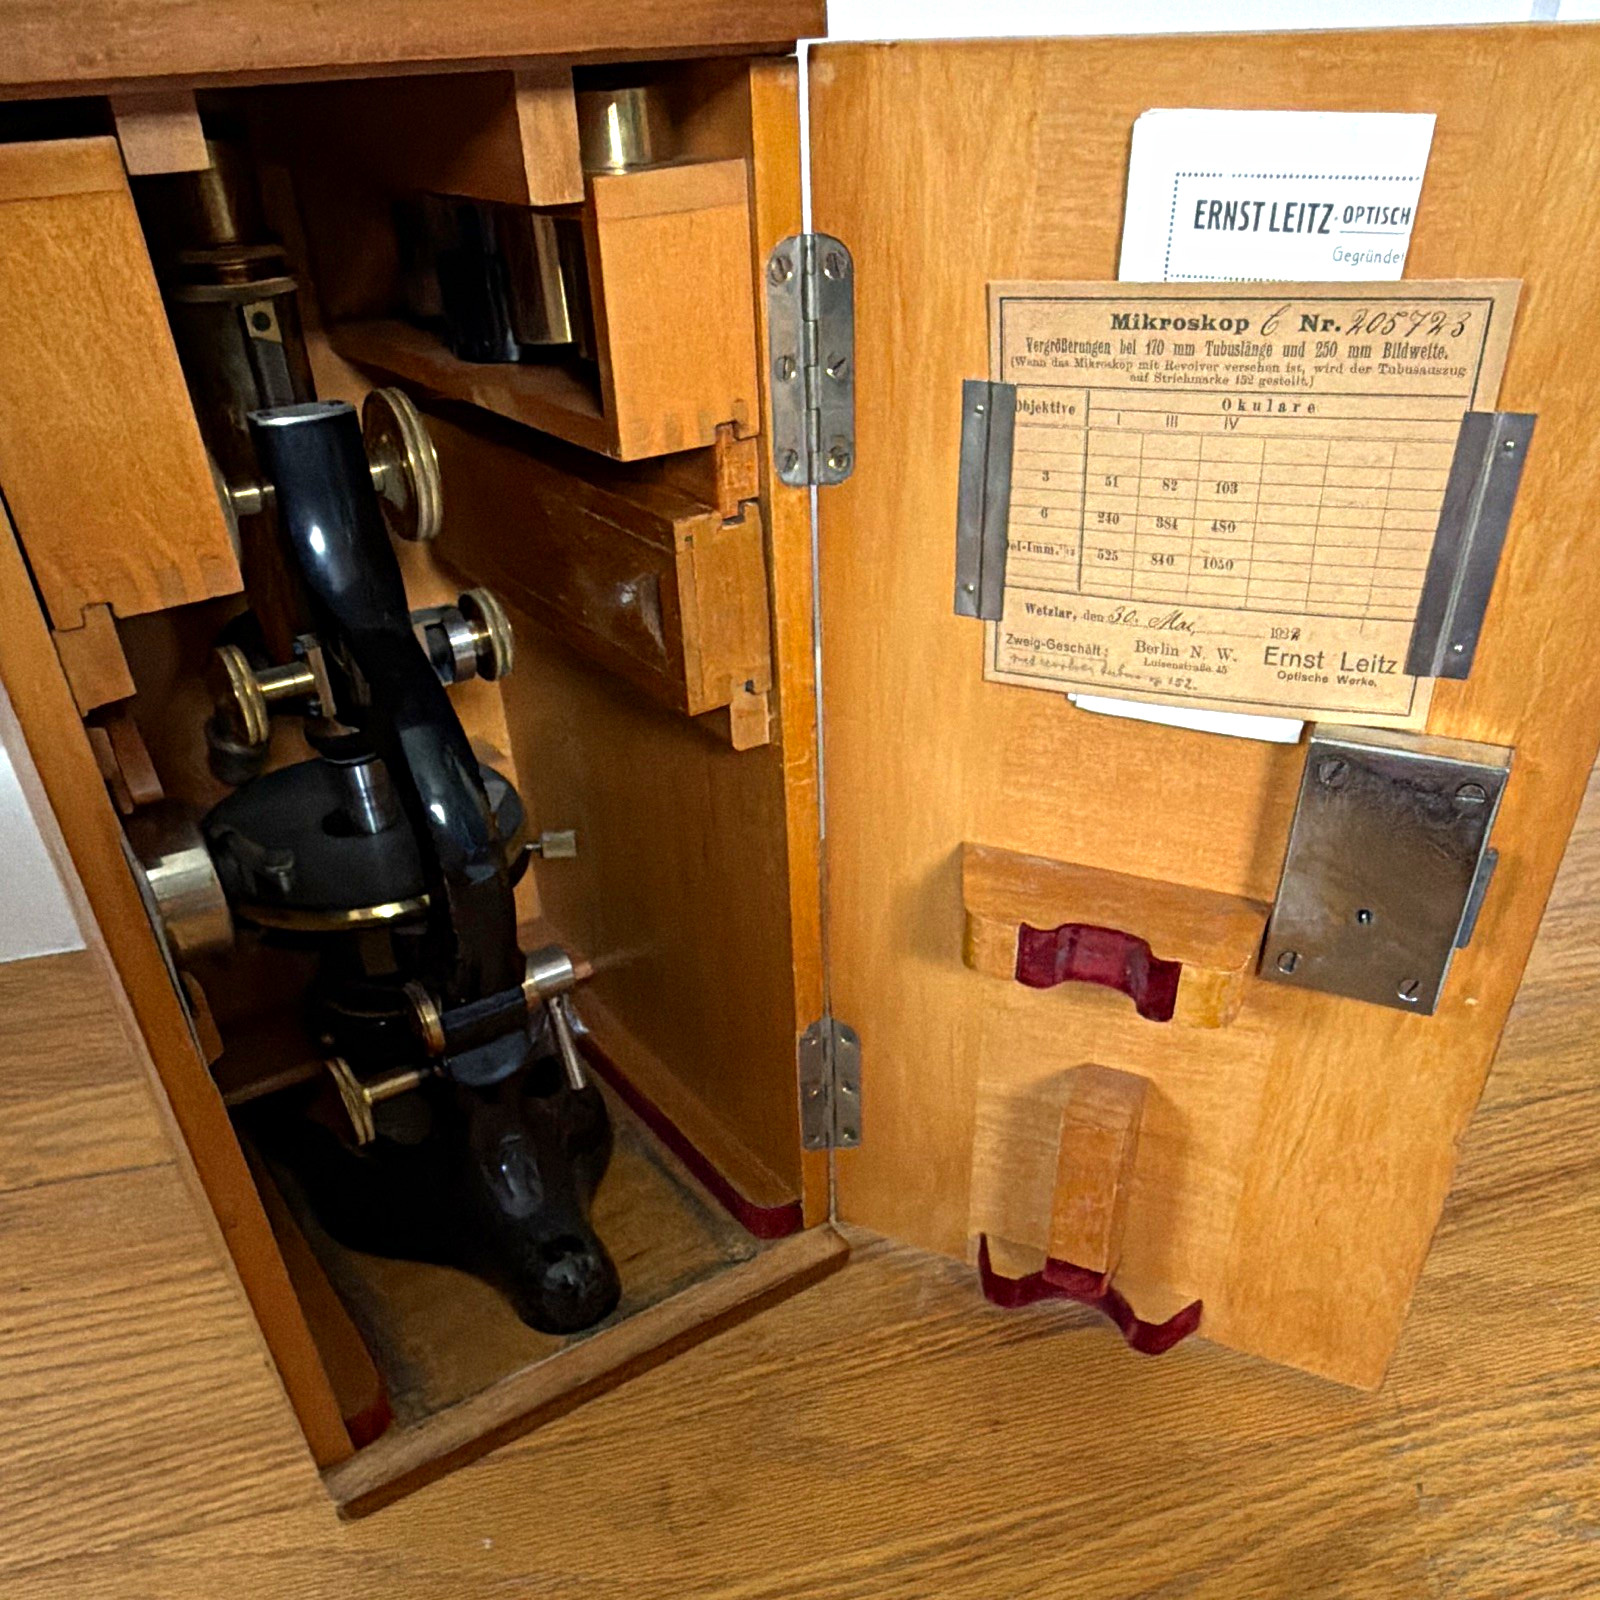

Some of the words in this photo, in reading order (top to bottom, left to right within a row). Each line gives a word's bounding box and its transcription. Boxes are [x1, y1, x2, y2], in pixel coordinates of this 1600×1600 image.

[1193, 199, 1265, 232] ERNST
[1268, 202, 1334, 234] LEITZ
[1342, 205, 1412, 226] OPTISCH
[1110, 313, 1250, 335] Mikroskop
[1298, 313, 1342, 333] Nr.
[1345, 308, 1472, 338] 205723
[1025, 336, 1111, 358] Vergrößerungen
[1120, 338, 1137, 356] bei
[1145, 339, 1165, 356] 170
[1172, 343, 1196, 357] mm
[1205, 340, 1273, 361] Tubuslänge
[1282, 341, 1306, 357] und
[1315, 341, 1338, 359] 250
[1347, 344, 1372, 359] mm
[1381, 341, 1449, 360] Bildweite.
[1051, 357, 1070, 368] das
[1074, 357, 1133, 372] Mikroskop
[1138, 357, 1160, 370] mit
[1164, 360, 1220, 372] Revolver
[1224, 361, 1281, 373] versehen
[1314, 362, 1344, 375] wird
[1349, 362, 1373, 375] der
[1378, 362, 1467, 379] Tubusauszug
[1129, 372, 1150, 384] auf
[1154, 372, 1229, 385] Strichmarke
[1235, 374, 1255, 386] 152
[1165, 414, 1179, 428] III
[1224, 415, 1239, 431] IV
[1041, 470, 1050, 482] 3
[1104, 475, 1119, 488] 51
[1162, 478, 1179, 492] 82
[1215, 481, 1239, 495] 103
[1040, 506, 1049, 519] 6
[1097, 512, 1120, 525] 240
[1210, 519, 1237, 534] 480
[1097, 549, 1119, 562] 525
[1151, 552, 1175, 567] 840
[1203, 556, 1234, 571] 1050
[1024, 602, 1077, 622] Wetzlar,
[1083, 609, 1104, 623] den
[1134, 639, 1180, 657] Berlin
[1216, 647, 1238, 663] W.
[1264, 645, 1325, 670] Ernst
[1340, 651, 1399, 676] Leitz
[1277, 670, 1329, 685] Optische
